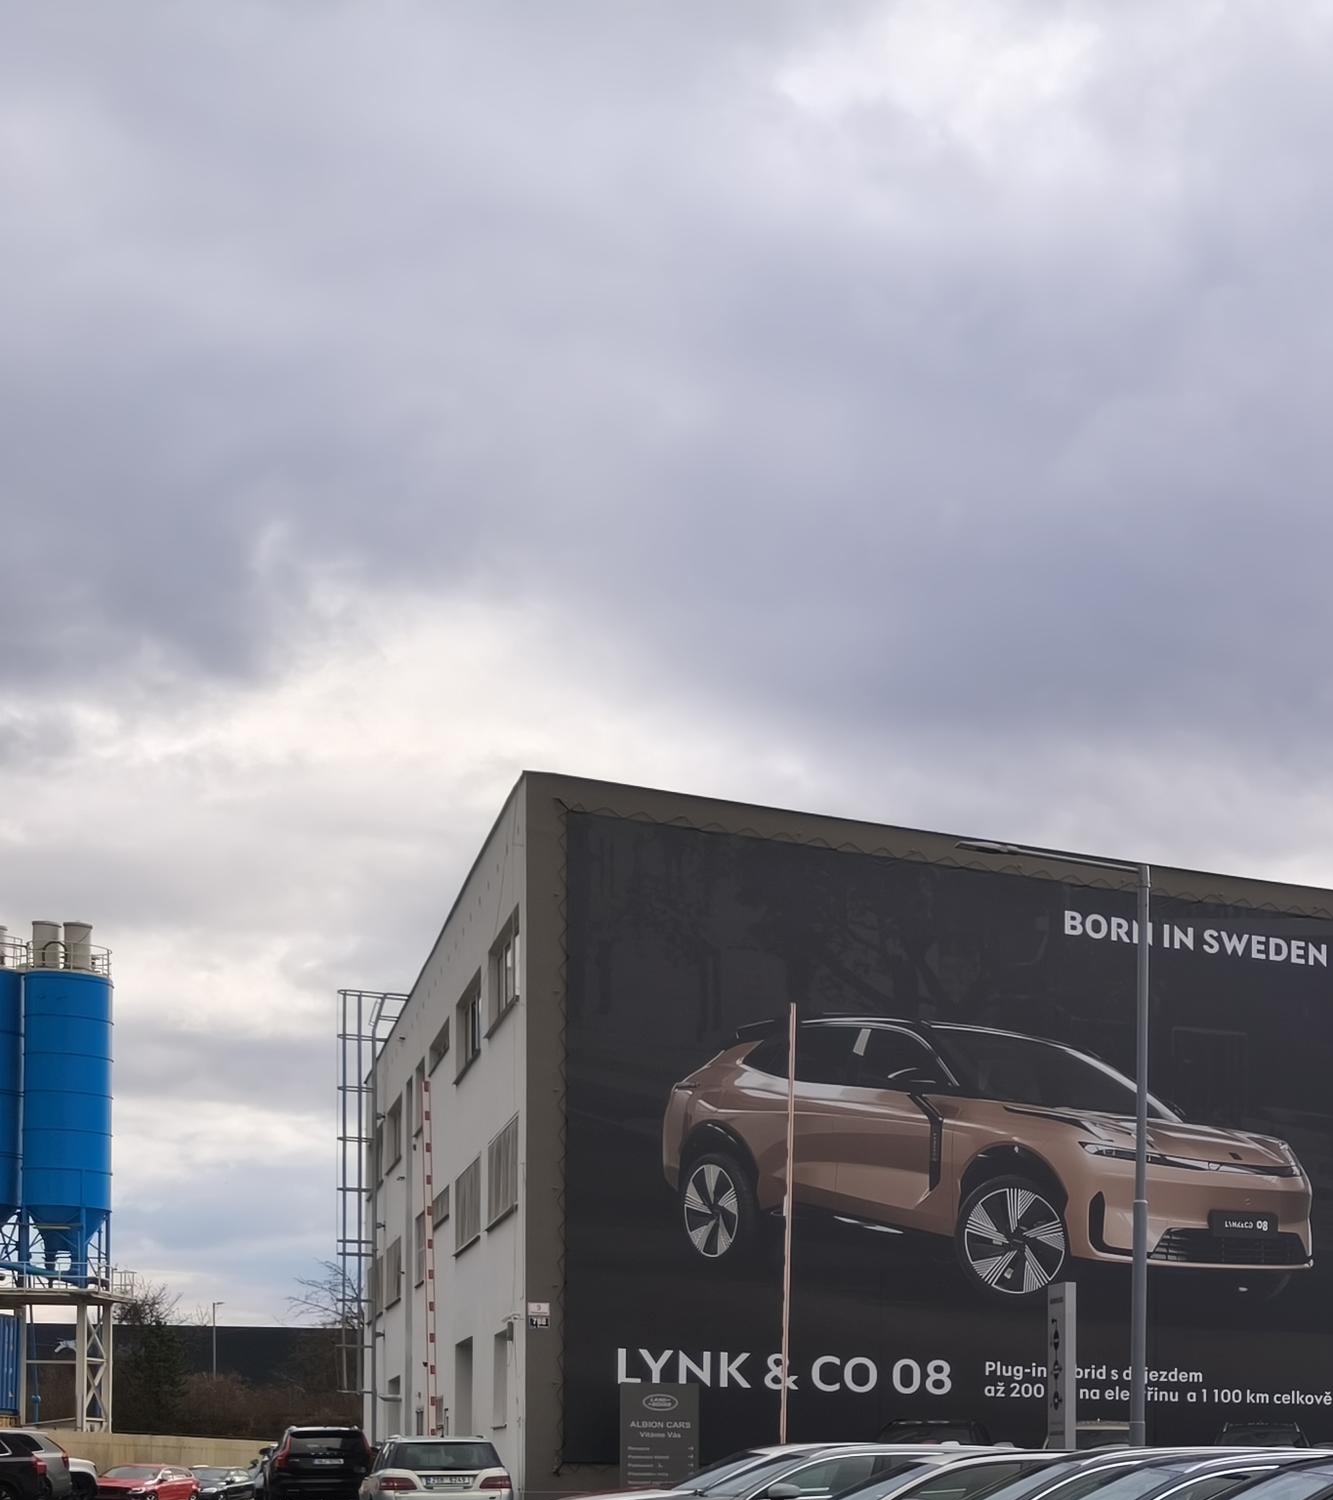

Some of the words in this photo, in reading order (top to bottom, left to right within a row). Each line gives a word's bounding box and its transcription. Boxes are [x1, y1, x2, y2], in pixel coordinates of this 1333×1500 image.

[1163, 924, 1194, 951] IN
[1203, 929, 1328, 967] SWEDEN
[617, 1348, 752, 1389] LYNK
[764, 1353, 799, 1391] &
[811, 1355, 878, 1393] CO
[892, 1358, 952, 1395] 08
[985, 1361, 1047, 1380] Plug-in
[1110, 1369, 1119, 1380] s
[1122, 1366, 1203, 1383] djezdem
[984, 1382, 1006, 1398] až
[1010, 1383, 1045, 1398] 200
[1080, 1388, 1100, 1400] na
[1104, 1386, 1179, 1403] eleřinu
[1186, 1390, 1197, 1403] a
[1213, 1389, 1243, 1403] 100
[1246, 1389, 1270, 1404] km
[1273, 1390, 1333, 1406] celkově
